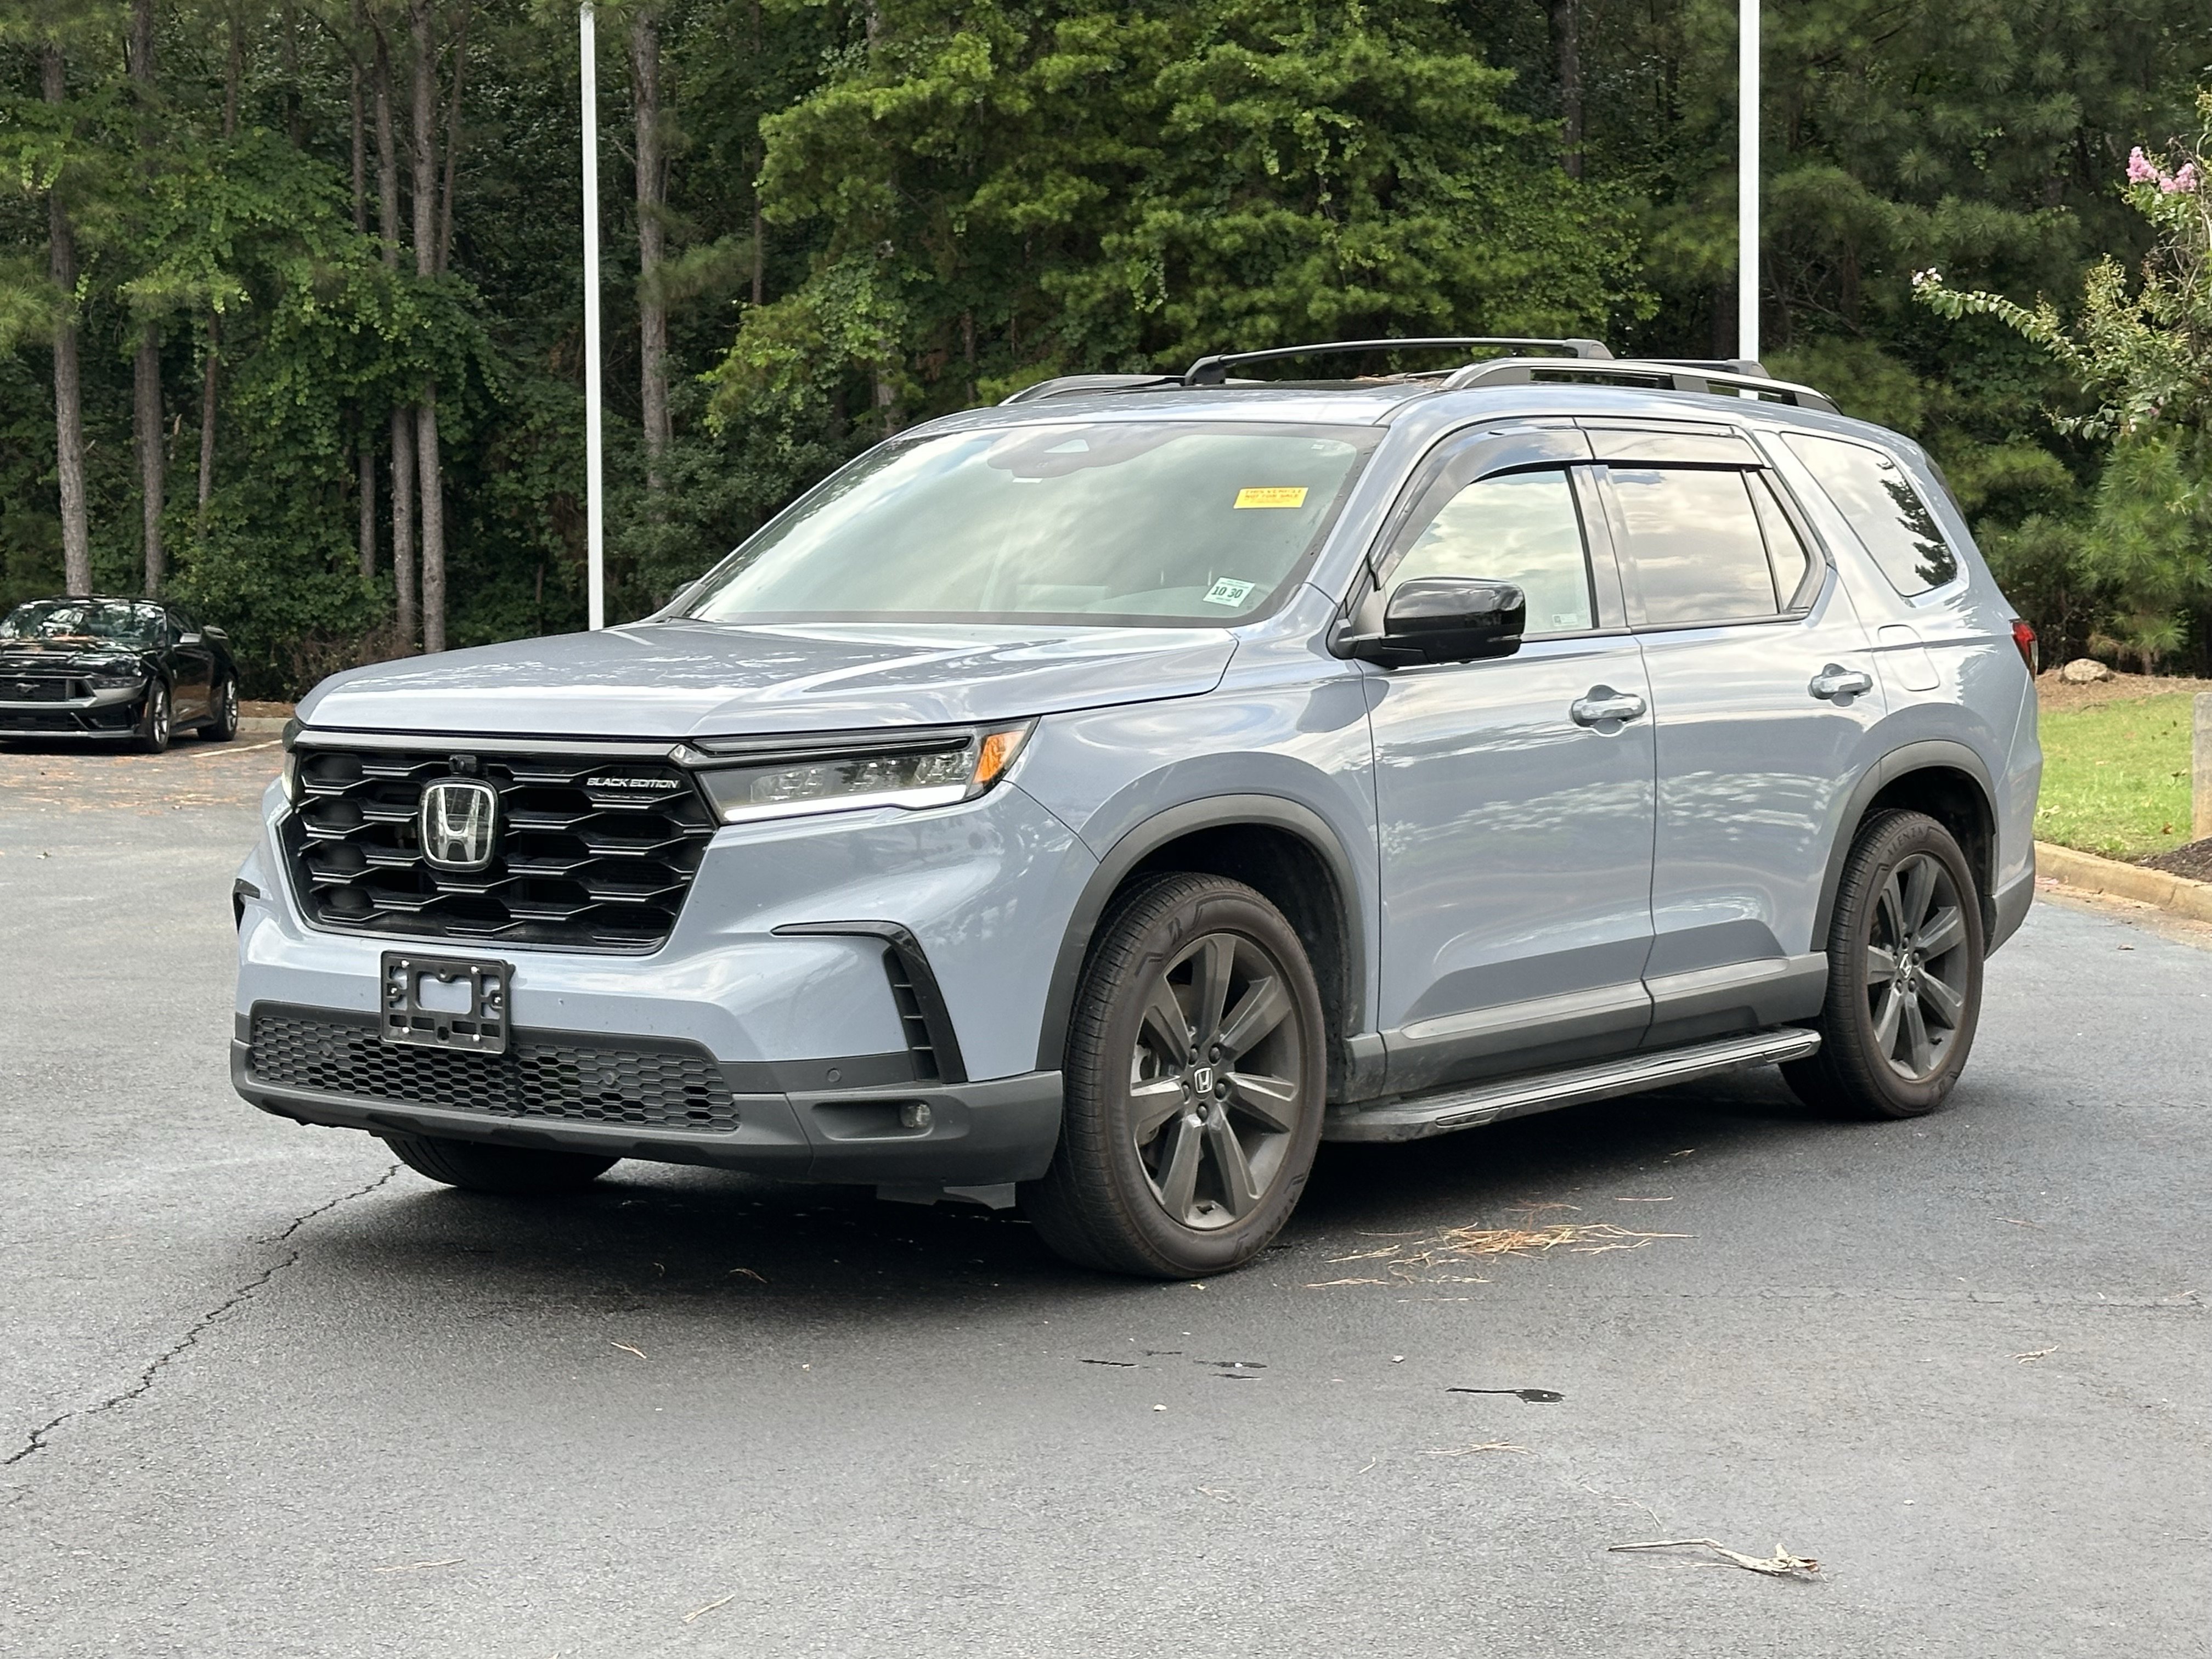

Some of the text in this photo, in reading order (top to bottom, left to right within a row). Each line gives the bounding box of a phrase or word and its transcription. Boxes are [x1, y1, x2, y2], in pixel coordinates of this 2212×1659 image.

[1211, 586, 1244, 599] 10 30
[586, 777, 680, 788] BLACK EDITION
